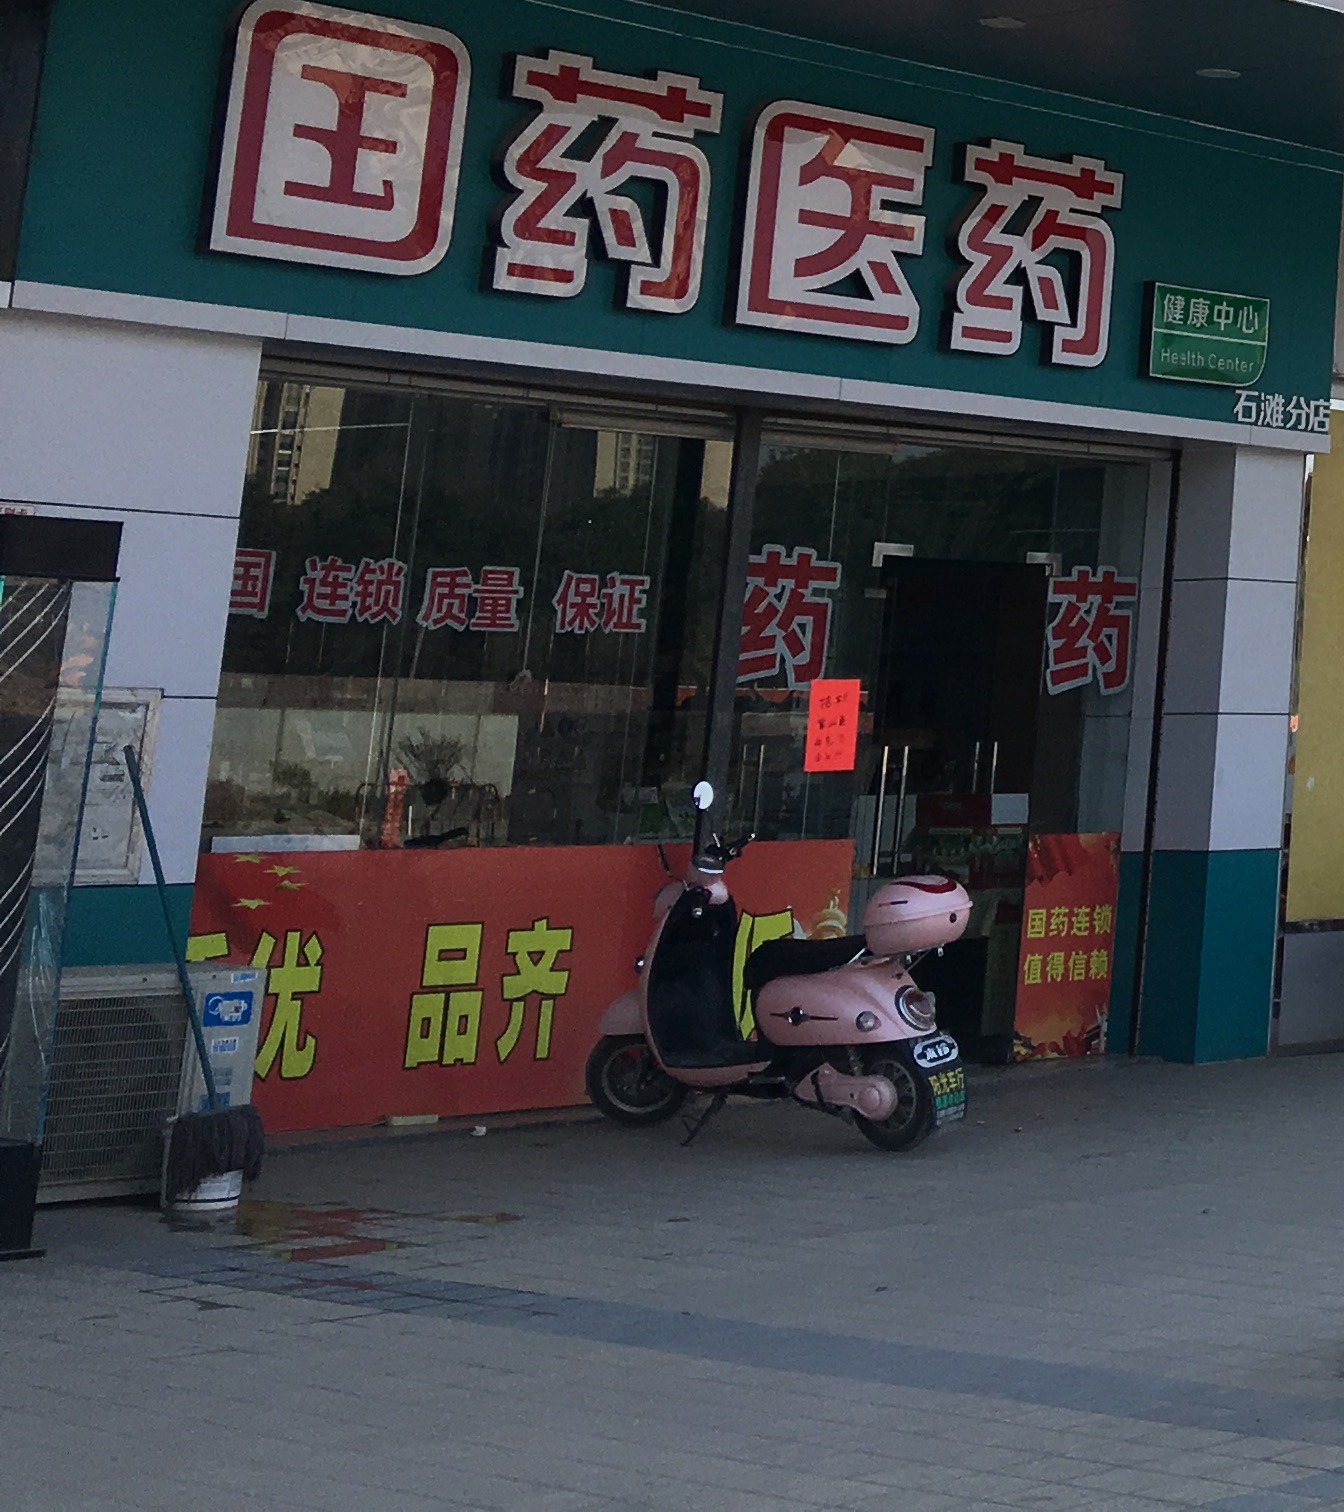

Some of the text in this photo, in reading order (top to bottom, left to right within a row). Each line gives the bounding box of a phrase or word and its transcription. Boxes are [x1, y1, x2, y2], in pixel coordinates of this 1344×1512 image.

[1163, 293, 1259, 334] 健康中心
[1160, 348, 1254, 373] Health Center
[1233, 389, 1331, 433] 石滩分店
[298, 555, 408, 626] 连锁
[419, 564, 522, 633] 质量
[552, 570, 652, 634] 保证
[736, 544, 841, 691] 药
[1046, 565, 1139, 696] 药
[1026, 904, 1111, 939] 国药连锁
[1023, 951, 1108, 985] 值得信赖
